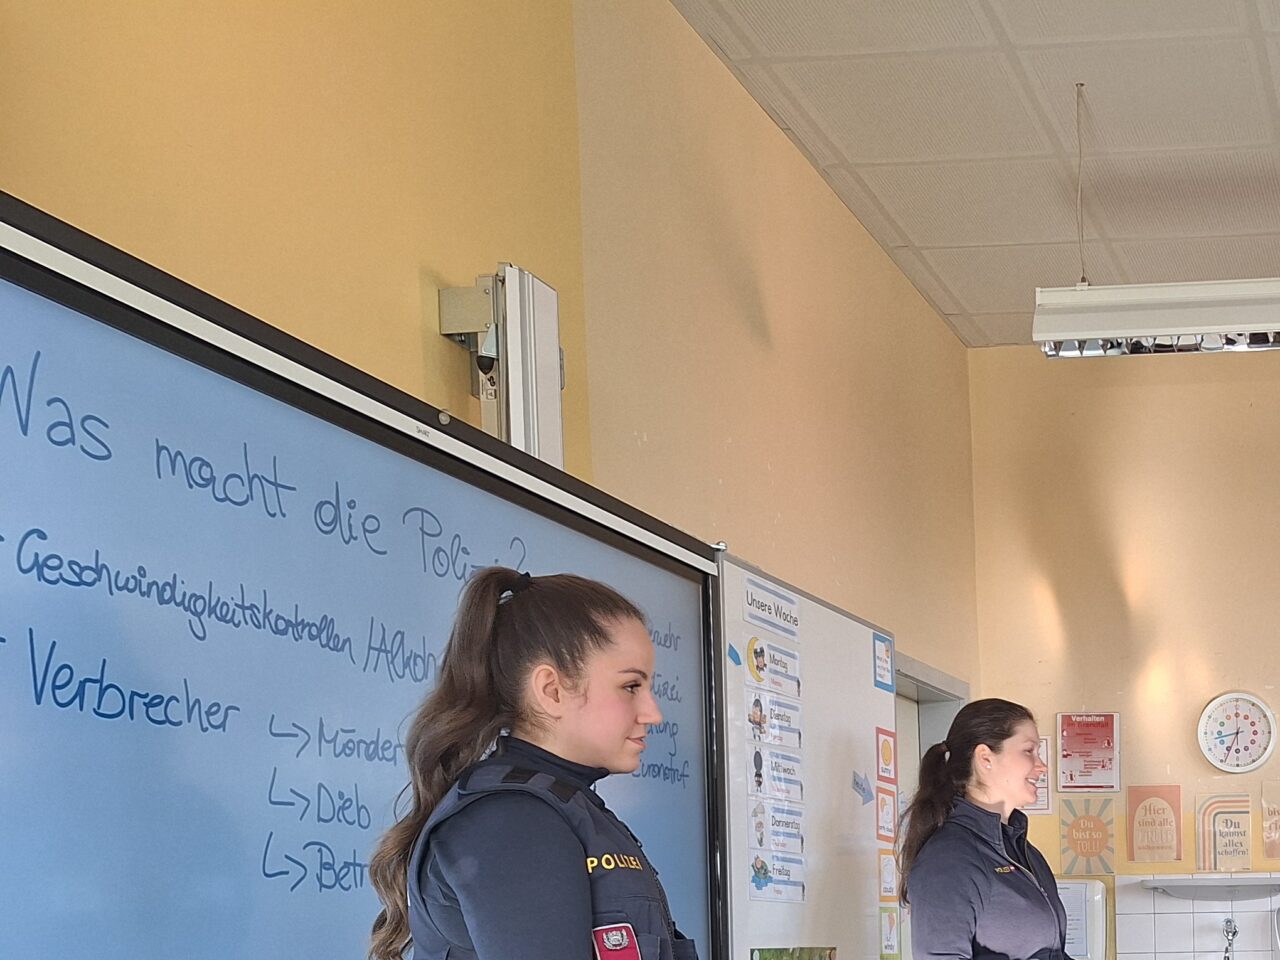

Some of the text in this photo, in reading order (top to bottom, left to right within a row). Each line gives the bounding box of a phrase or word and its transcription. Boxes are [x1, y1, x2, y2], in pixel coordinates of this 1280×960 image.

[155, 437, 296, 518] macht
[314, 481, 388, 555] die
[746, 589, 798, 627] Unsere Woche
[769, 653, 788, 673] Montag
[28, 627, 241, 733] Verbrecher
[1071, 714, 1105, 722] Verhalten
[317, 782, 371, 830] Dieb
[1141, 803, 1167, 817] Hier
[771, 815, 800, 833] Donnerstag
[1080, 819, 1094, 829] Du
[1137, 817, 1174, 827] sind alle
[1221, 818, 1241, 829] Du
[1072, 829, 1103, 839] bist so
[1218, 829, 1247, 838] kannst
[1076, 840, 1100, 852] TOLL!
[1222, 840, 1244, 848] alles
[1217, 848, 1249, 858] schaffen!
[303, 841, 369, 893] Betr
[586, 853, 643, 874] POLIZEI
[772, 863, 791, 880] Freitag
